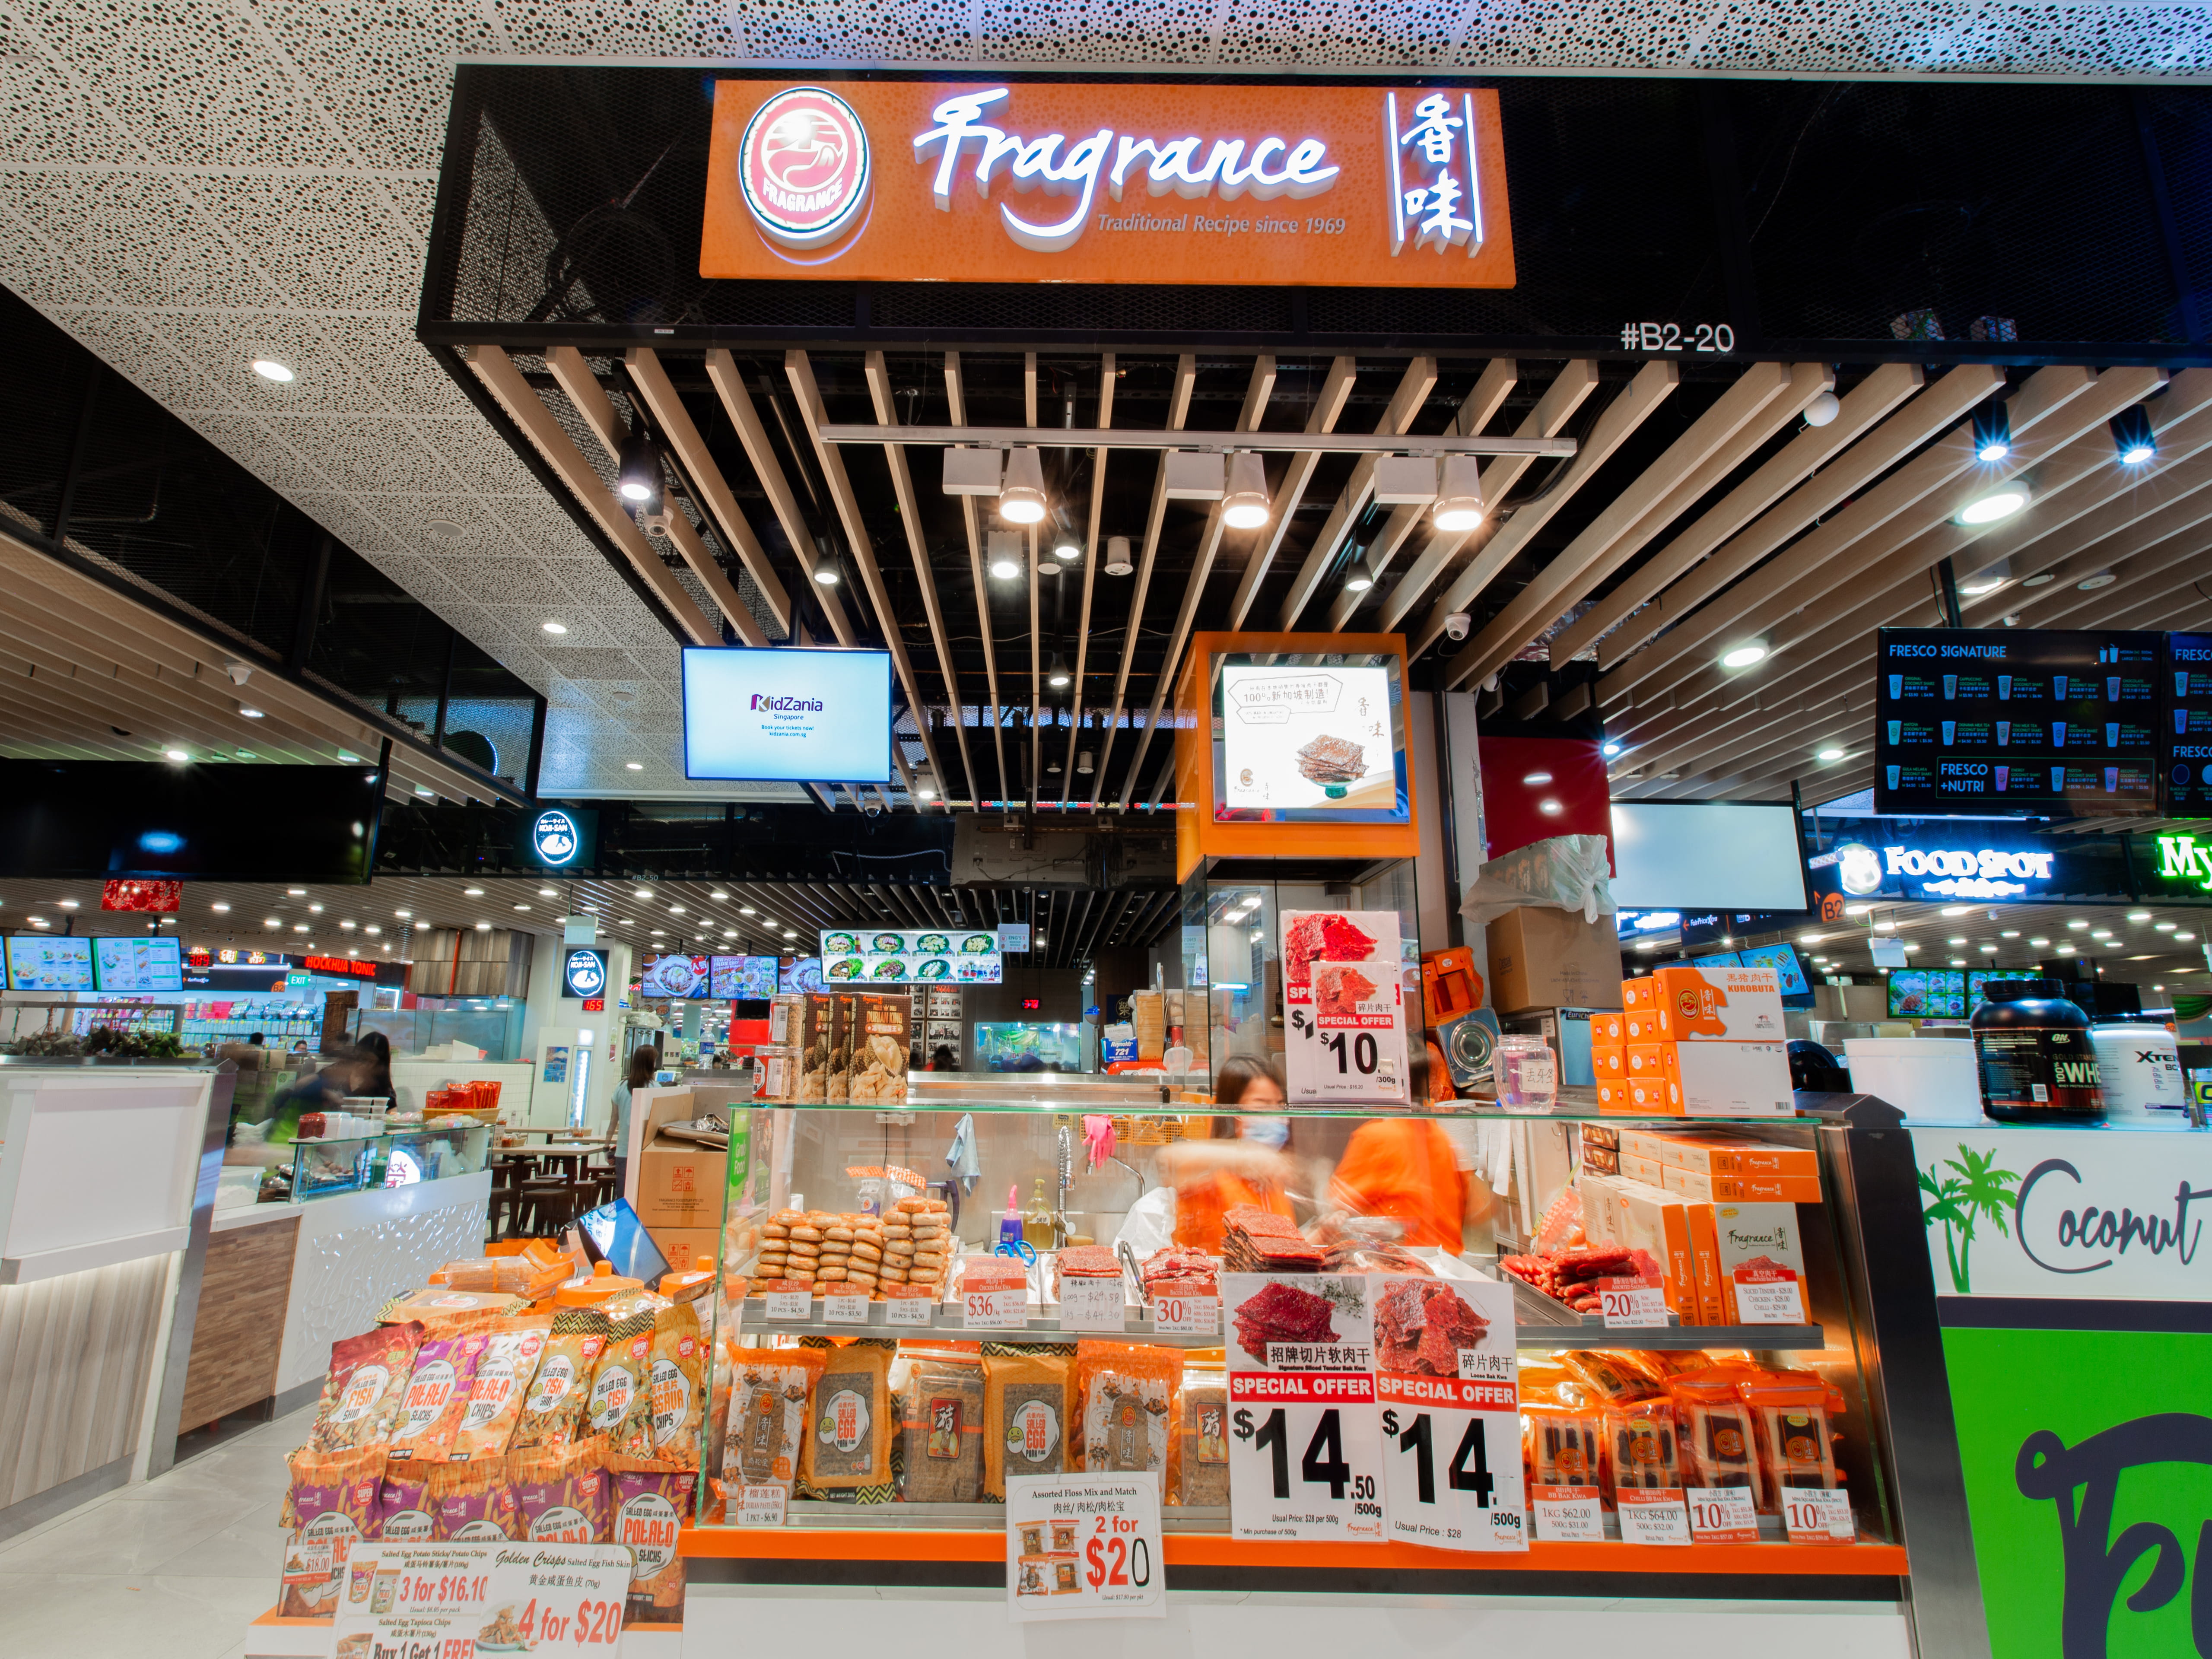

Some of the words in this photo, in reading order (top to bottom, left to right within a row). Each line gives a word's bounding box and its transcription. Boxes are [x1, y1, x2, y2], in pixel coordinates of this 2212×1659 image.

[914, 88, 1340, 238] Fragrance
[1401, 92, 1474, 236] 香味
[762, 176, 843, 212] FRAGRANCE
[1098, 213, 1188, 232] Traditional
[1193, 214, 1249, 237] Recipe
[1255, 215, 1298, 234] since
[1306, 217, 1346, 235] 1969
[1621, 322, 1734, 352] #B2-20
[1889, 645, 1937, 657] FRESCO
[1941, 645, 2006, 658] SIGNATURE
[2175, 649, 2212, 661] FRESC
[750, 694, 823, 712] KidZania
[1941, 763, 1988, 775] FRESCO
[1940, 780, 1984, 792] +NUTRI
[1823, 899, 1844, 919] B2
[305, 955, 348, 973] HOCKHUA
[350, 962, 376, 977] TONIC
[291, 976, 306, 985] EXIT
[1728, 985, 1775, 993] KUROBUTA
[585, 1001, 602, 1010] 165
[1358, 1003, 1392, 1013] 碎片肉干
[867, 1011, 887, 1023] DURIAN
[889, 1012, 903, 1023] KING
[1319, 1017, 1359, 1026] SPECIAL
[1361, 1016, 1392, 1026] OFFER
[2051, 1034, 2067, 1042] ON
[1376, 1076, 1396, 1084] /300g
[2054, 1062, 2065, 1083] 100%
[2063, 1062, 2101, 1084] WHE
[735, 1142, 746, 1158] Grab
[734, 1157, 746, 1176] Food
[2015, 1158, 2212, 1275] Coconut
[1727, 1229, 1773, 1250] Fragrance
[968, 1295, 993, 1318] $36
[1157, 1299, 1192, 1322] 30%
[1605, 1294, 1639, 1317] 20%
[1085, 1309, 1119, 1321] $49.30
[522, 1342, 538, 1351] SUPER
[583, 1343, 599, 1352] SUPER
[633, 1342, 647, 1352] SUPER
[1270, 1345, 1370, 1364] 招牌切片软肉干
[1462, 1353, 1513, 1374] 碎片肉干
[543, 1378, 564, 1395] FISH
[1233, 1377, 1309, 1395] SPECIAL
[1313, 1378, 1372, 1395] OFFER
[1379, 1376, 1458, 1401] SPECIAL
[1462, 1386, 1515, 1404] OFFER
[347, 1387, 375, 1409] FISH
[607, 1390, 626, 1409] FISH
[471, 1403, 496, 1418] CHIPS
[656, 1413, 674, 1430] CHIPS
[837, 1419, 856, 1439] EGG
[1026, 1429, 1046, 1449] EGG
[582, 1478, 599, 1489] SUPER
[356, 1487, 373, 1499] SUPER
[1032, 1489, 1063, 1499] Assorted
[1064, 1488, 1083, 1497] Floss
[1100, 1487, 1113, 1496] and
[1115, 1487, 1137, 1496] Match
[1354, 1503, 1382, 1517] /500g
[1543, 1508, 1560, 1517] 1KG
[1562, 1508, 1591, 1519] $62.00
[1628, 1509, 1646, 1520] 1KG
[1649, 1510, 1678, 1521] $64.00
[1692, 1503, 1730, 1529] 10%
[1787, 1503, 1826, 1529] 10%
[1095, 1516, 1106, 1533] 2
[1112, 1515, 1138, 1533] for
[1272, 1514, 1287, 1522] Usual
[1288, 1514, 1304, 1522] Price:
[1305, 1514, 1315, 1523] $28
[1316, 1516, 1325, 1524] per
[1326, 1515, 1338, 1525] 500g
[1490, 1513, 1521, 1529] /500g
[1395, 1520, 1417, 1533] Usual
[1420, 1523, 1440, 1536] Price
[1446, 1526, 1462, 1538] $28
[432, 1550, 451, 1558] Sticks/
[470, 1550, 487, 1558] Chips
[495, 1549, 530, 1568] Golden
[533, 1551, 567, 1569] Crisps
[567, 1558, 587, 1567] Salted
[588, 1559, 601, 1568] Egg
[601, 1559, 615, 1567] Fish
[615, 1560, 630, 1568] Skin
[305, 1557, 330, 1573] $18.00
[1086, 1535, 1150, 1593] $20
[400, 1576, 410, 1602] 3
[413, 1576, 436, 1602] for
[438, 1574, 489, 1605] $16.10
[528, 1573, 584, 1588] 黄金咸蛋鱼皮
[585, 1579, 601, 1589] (70g)
[397, 1619, 409, 1627] Egg
[410, 1618, 433, 1627] Tapioca
[434, 1618, 451, 1627] Chips
[518, 1598, 537, 1640] 4
[540, 1607, 571, 1641] for
[574, 1597, 622, 1648] $20
